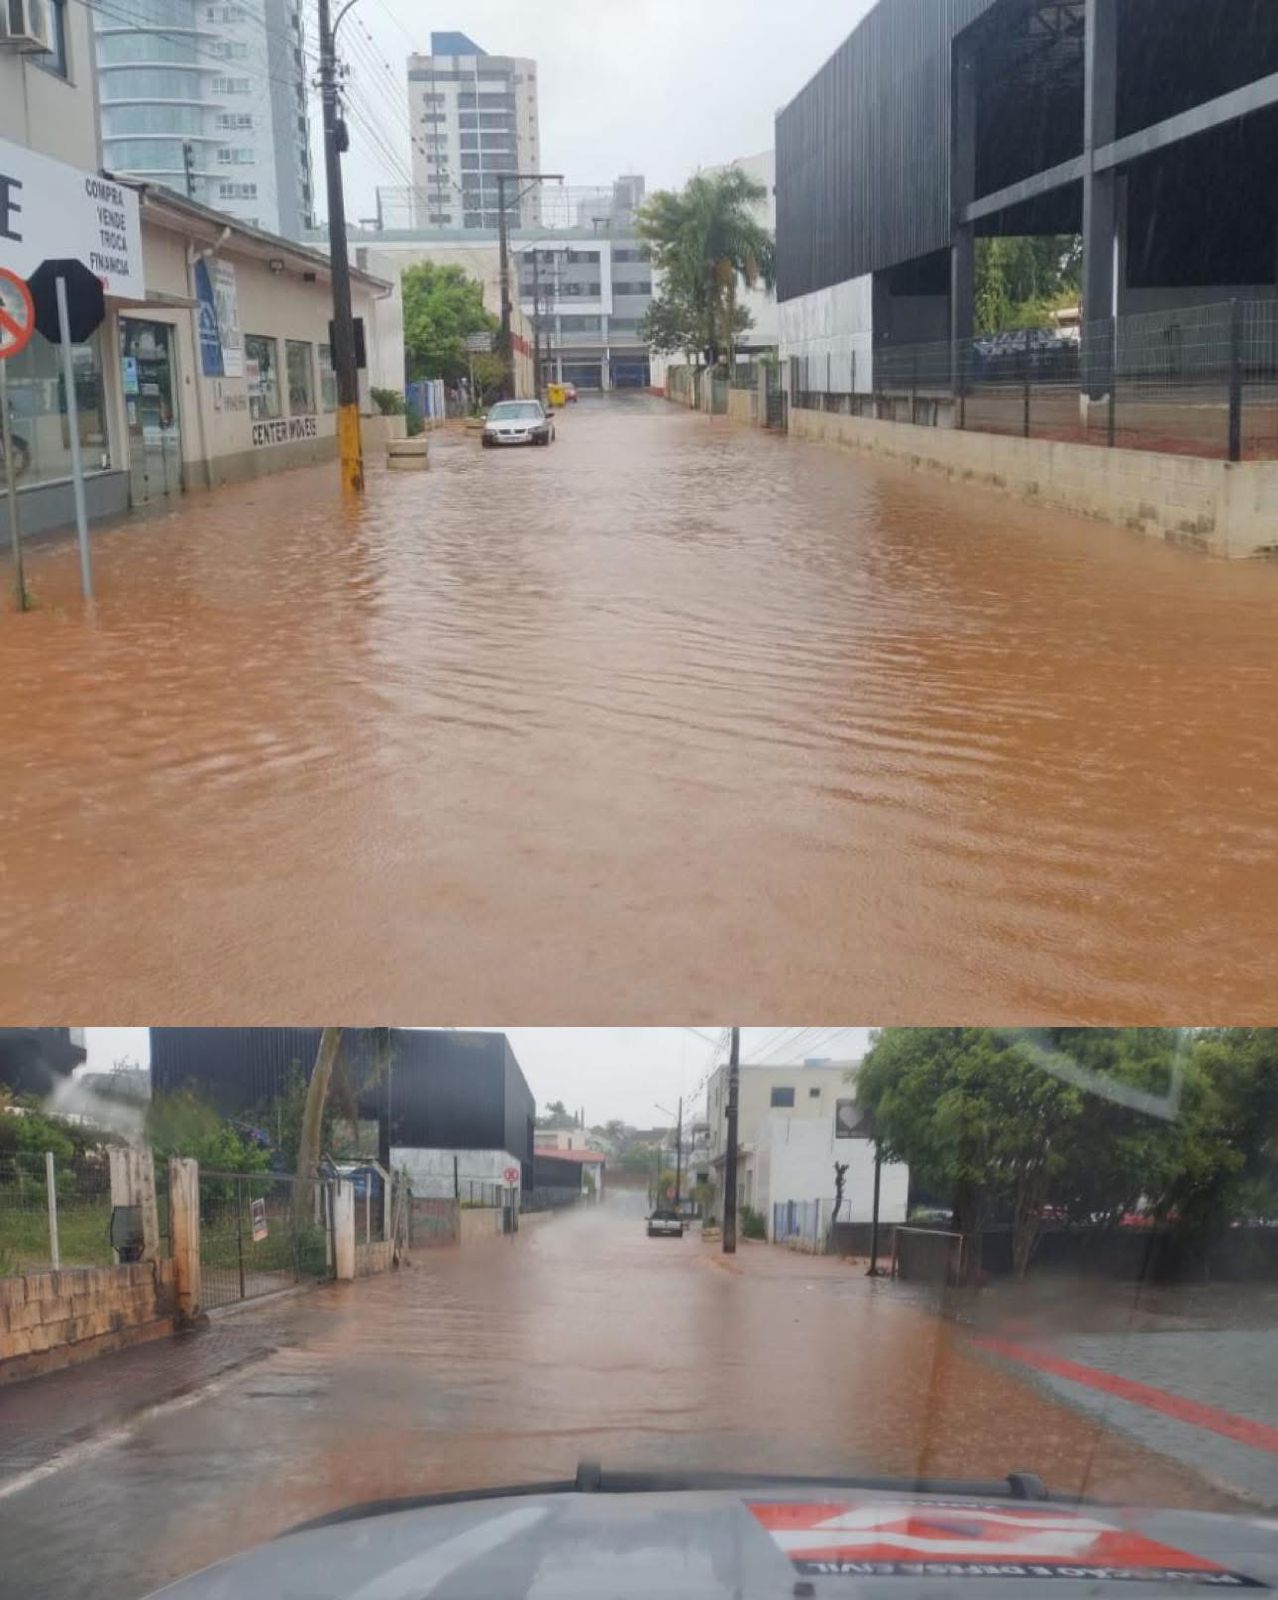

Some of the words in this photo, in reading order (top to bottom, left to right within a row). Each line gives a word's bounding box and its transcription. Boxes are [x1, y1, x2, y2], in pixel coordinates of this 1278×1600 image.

[85, 178, 125, 207] COMPRA
[97, 205, 126, 231] VENDE
[100, 229, 128, 252] TROCA
[90, 251, 130, 276] FINANCIA
[252, 421, 287, 446] CENTER
